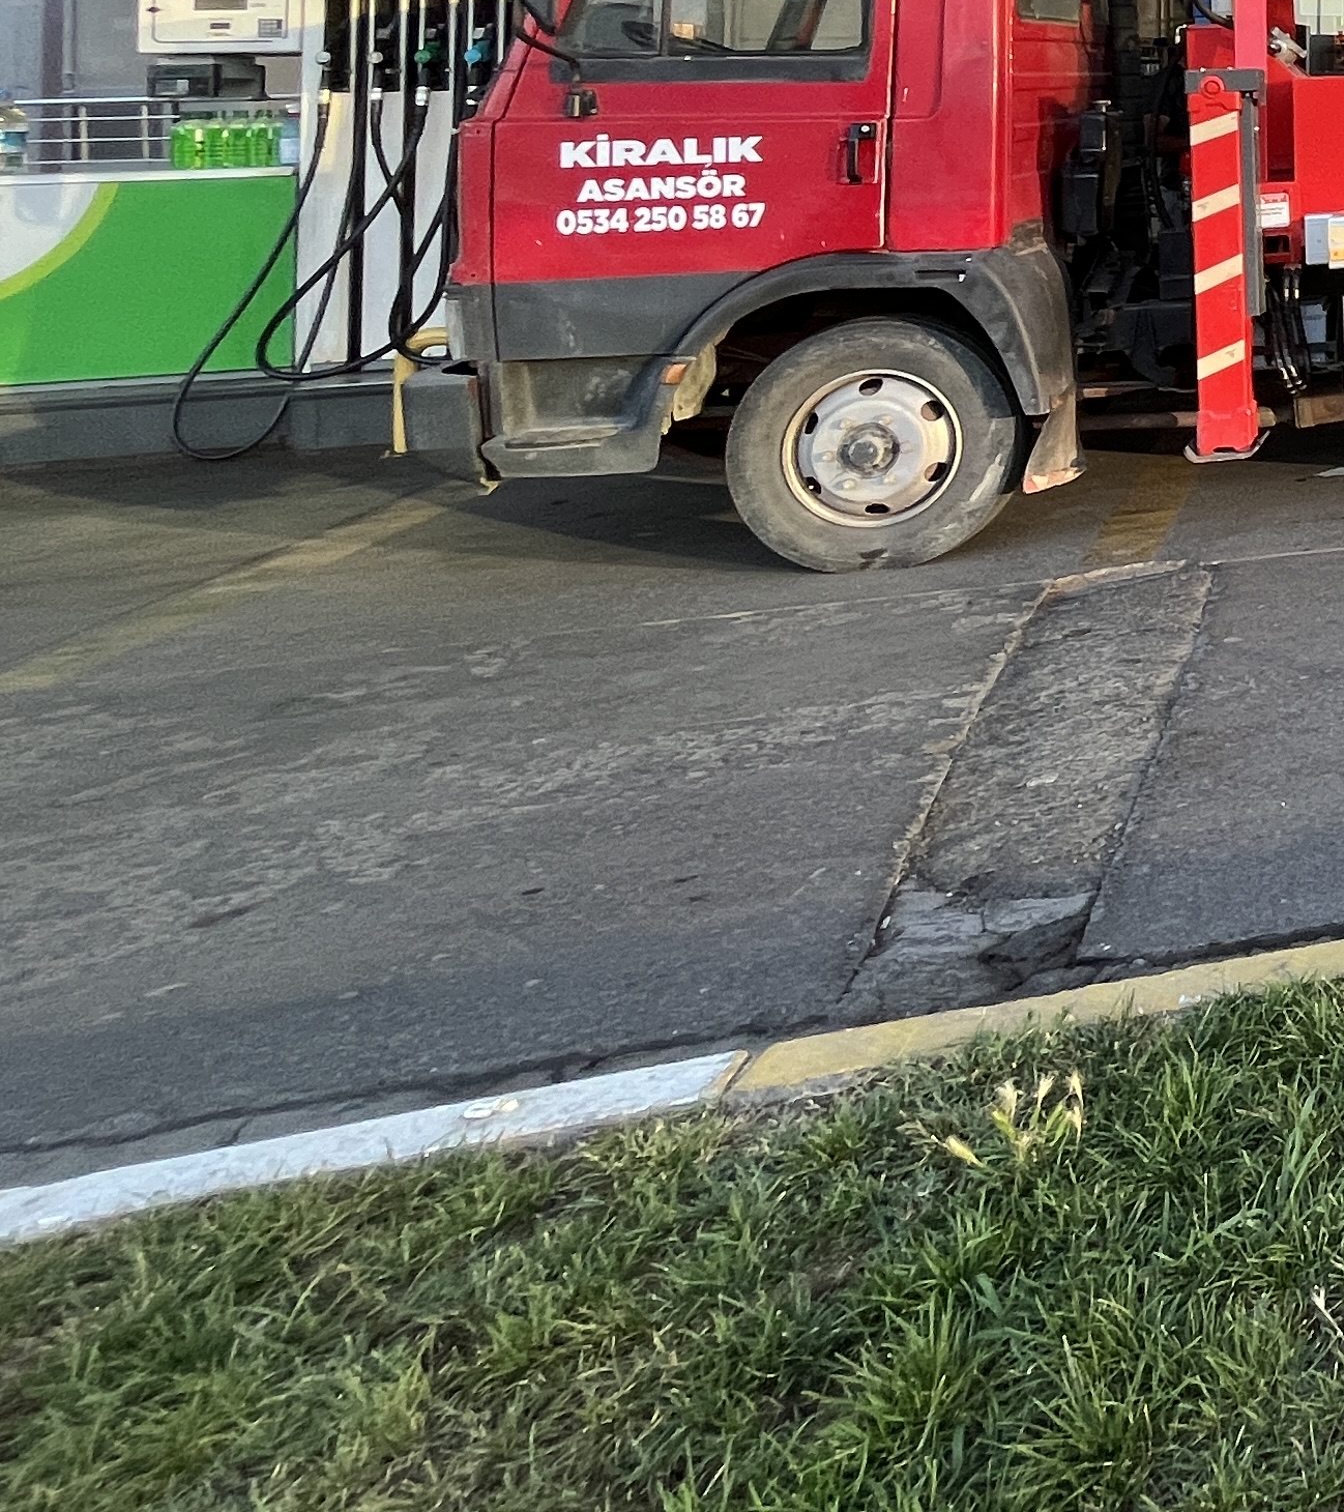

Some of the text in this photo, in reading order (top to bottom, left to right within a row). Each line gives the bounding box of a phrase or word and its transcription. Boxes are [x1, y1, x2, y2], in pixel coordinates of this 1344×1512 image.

[559, 133, 763, 169] KİRALIK
[576, 164, 747, 203] ASANSÖR
[556, 203, 766, 236] 0534 250 58 67
